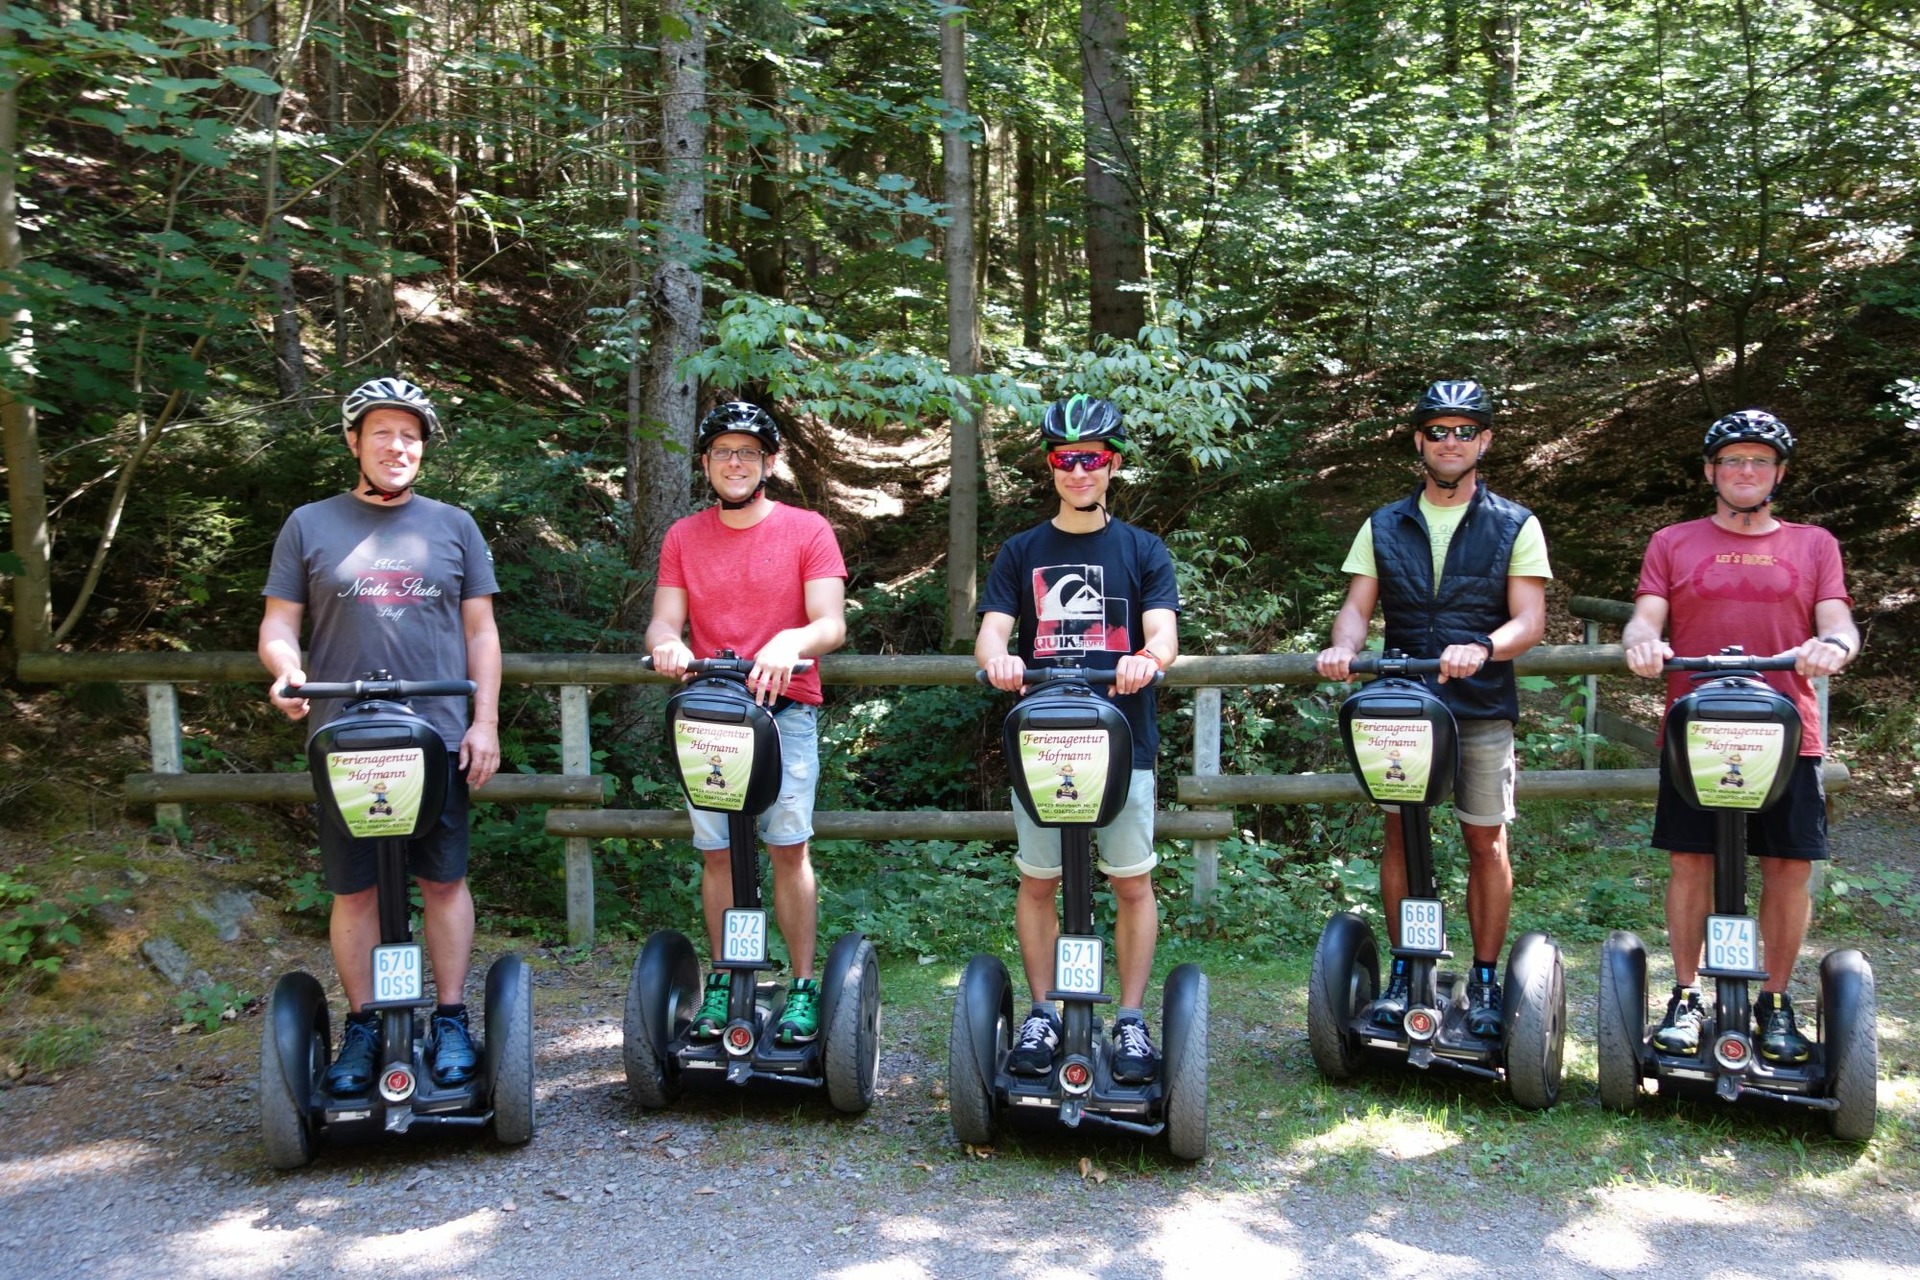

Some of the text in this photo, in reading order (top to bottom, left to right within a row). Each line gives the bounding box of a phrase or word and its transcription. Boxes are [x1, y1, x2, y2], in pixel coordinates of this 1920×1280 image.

[337, 576, 442, 597] North States
[678, 723, 751, 740] Ferienagentur
[1355, 721, 1429, 736] Ferienagentur
[1691, 723, 1780, 739] Ferienagentur
[690, 739, 739, 754] Hofmann
[1023, 733, 1105, 748] Ferienagentur
[1368, 736, 1417, 750] Hofmann
[1704, 740, 1764, 754] Hofmann
[331, 753, 419, 768] Ferienagentur
[1038, 749, 1093, 765] Hofmann
[348, 769, 407, 784] Hofmann
[1405, 904, 1436, 923] 668
[730, 914, 760, 934] 672
[1713, 921, 1749, 943] 674
[1407, 926, 1436, 945] OSS
[730, 937, 759, 957] OSS
[1062, 943, 1094, 964] 671
[1715, 945, 1749, 966] OSS
[379, 950, 414, 972] 670
[381, 975, 415, 996] OSS
[1063, 967, 1095, 988] OSS
